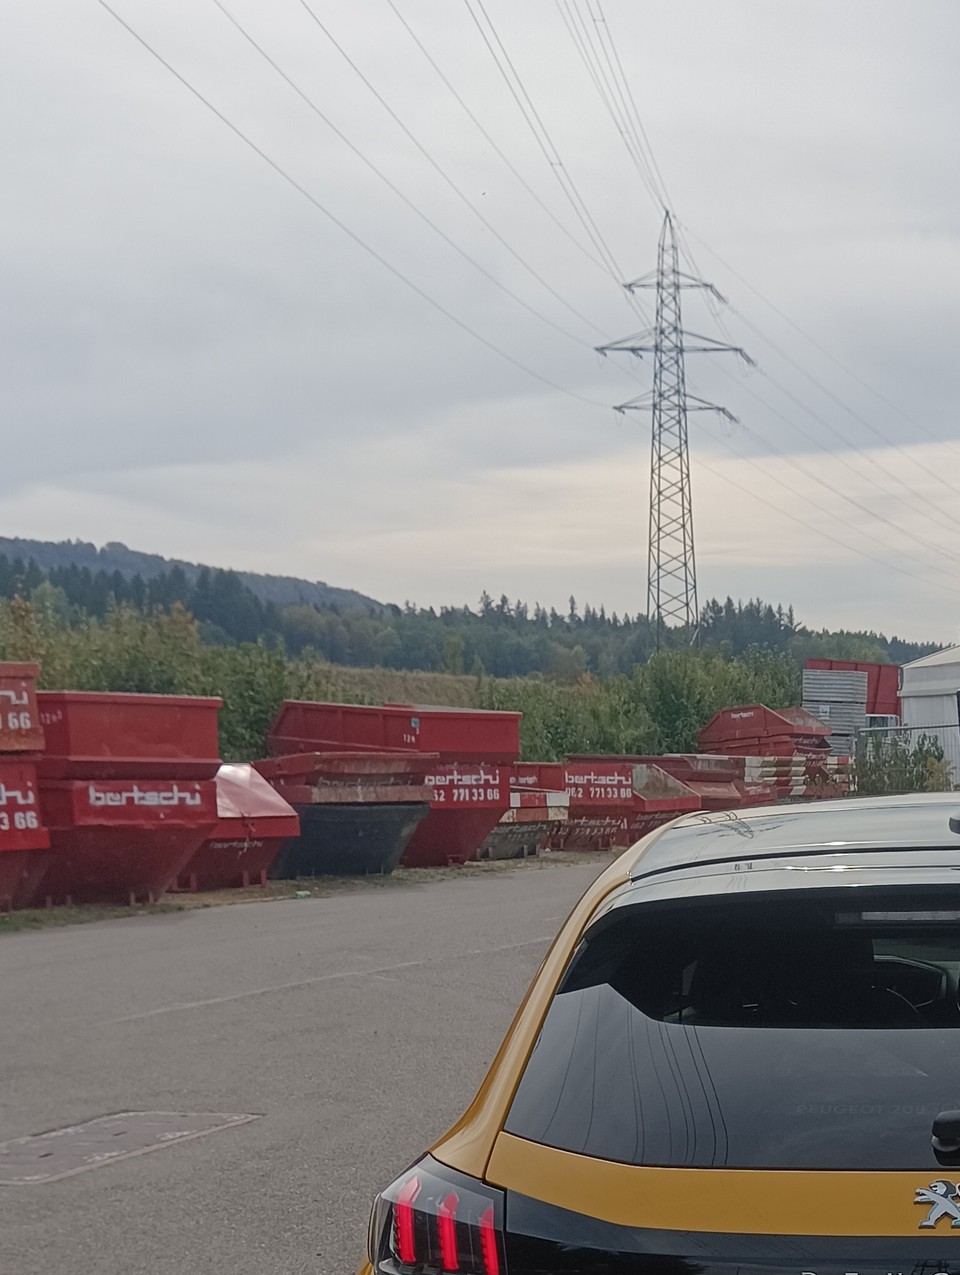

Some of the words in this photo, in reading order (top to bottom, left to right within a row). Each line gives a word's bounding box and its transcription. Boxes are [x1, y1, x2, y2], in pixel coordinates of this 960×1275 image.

[8, 712, 31, 729] 66
[565, 771, 631, 784] bertschi
[88, 784, 201, 806] bertschi
[453, 788, 469, 801] 771
[472, 788, 485, 801] 33
[487, 788, 500, 801] 66
[590, 787, 605, 799] 771
[607, 787, 618, 798] 33
[15, 811, 38, 829] 66
